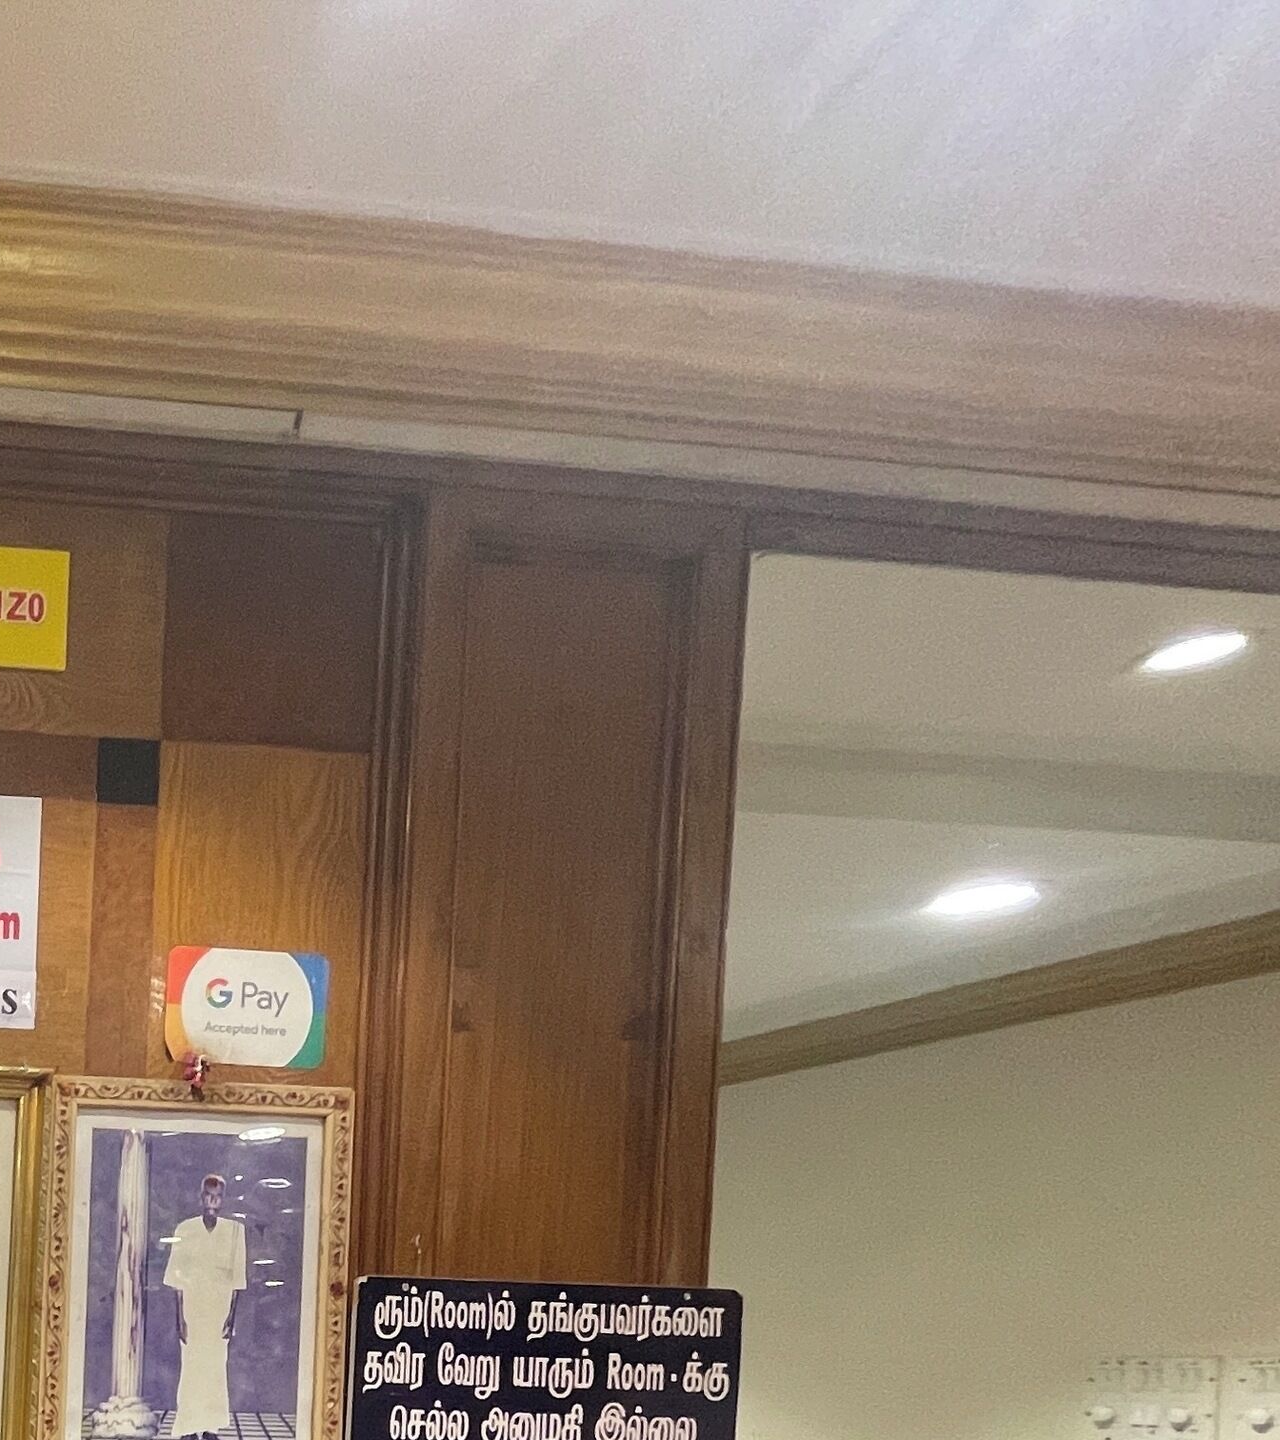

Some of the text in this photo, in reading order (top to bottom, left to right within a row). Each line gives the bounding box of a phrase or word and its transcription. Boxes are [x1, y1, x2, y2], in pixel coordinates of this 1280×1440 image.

[240, 981, 290, 1018] Pay
[203, 1021, 287, 1037] Accepted here
[525, 1291, 726, 1343] தங்குபவர்களை
[361, 1341, 427, 1394] தவிர
[436, 1341, 501, 1400] வேறு
[512, 1347, 596, 1400] யாரும்
[606, 1352, 665, 1392] Room
